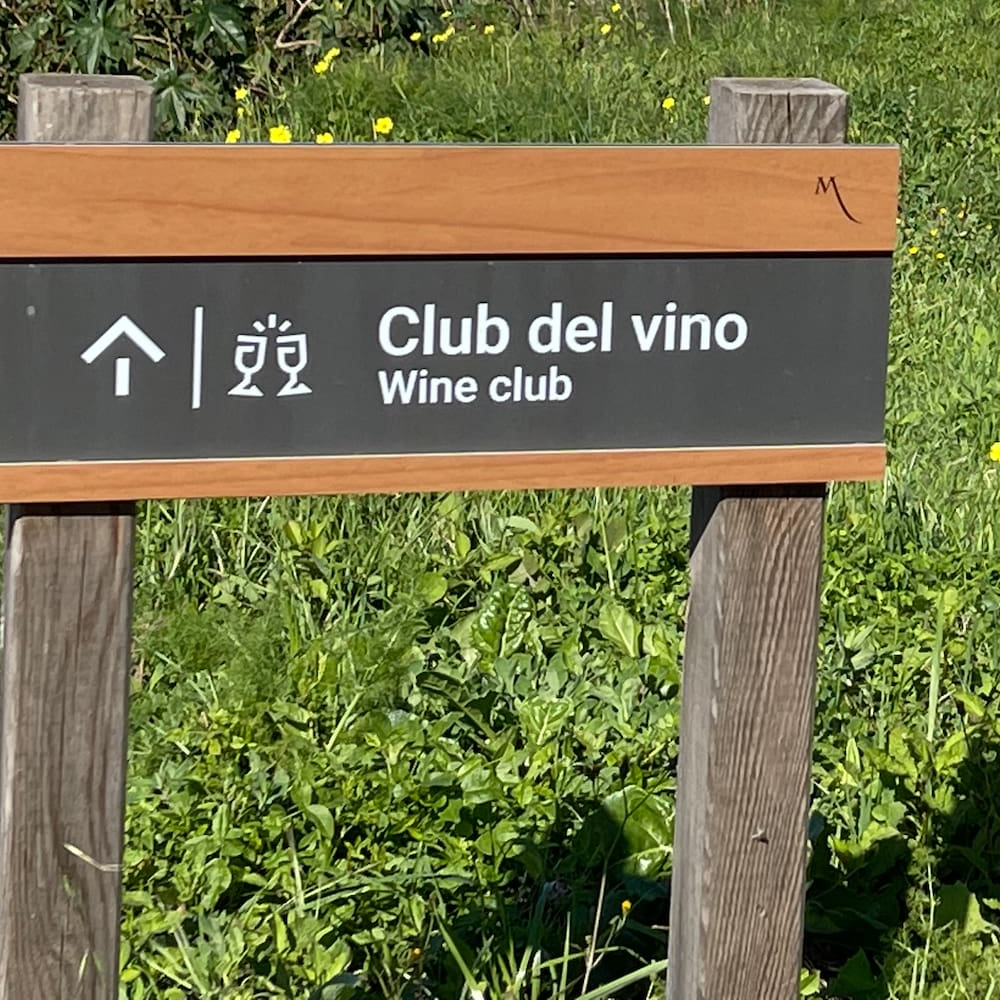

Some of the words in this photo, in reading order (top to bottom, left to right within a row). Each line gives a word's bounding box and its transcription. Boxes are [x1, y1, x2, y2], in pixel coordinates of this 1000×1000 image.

[378, 303, 511, 357] Club
[528, 301, 614, 354] del
[631, 301, 749, 352] vino
[378, 369, 478, 405] Wine
[488, 365, 573, 402] club
